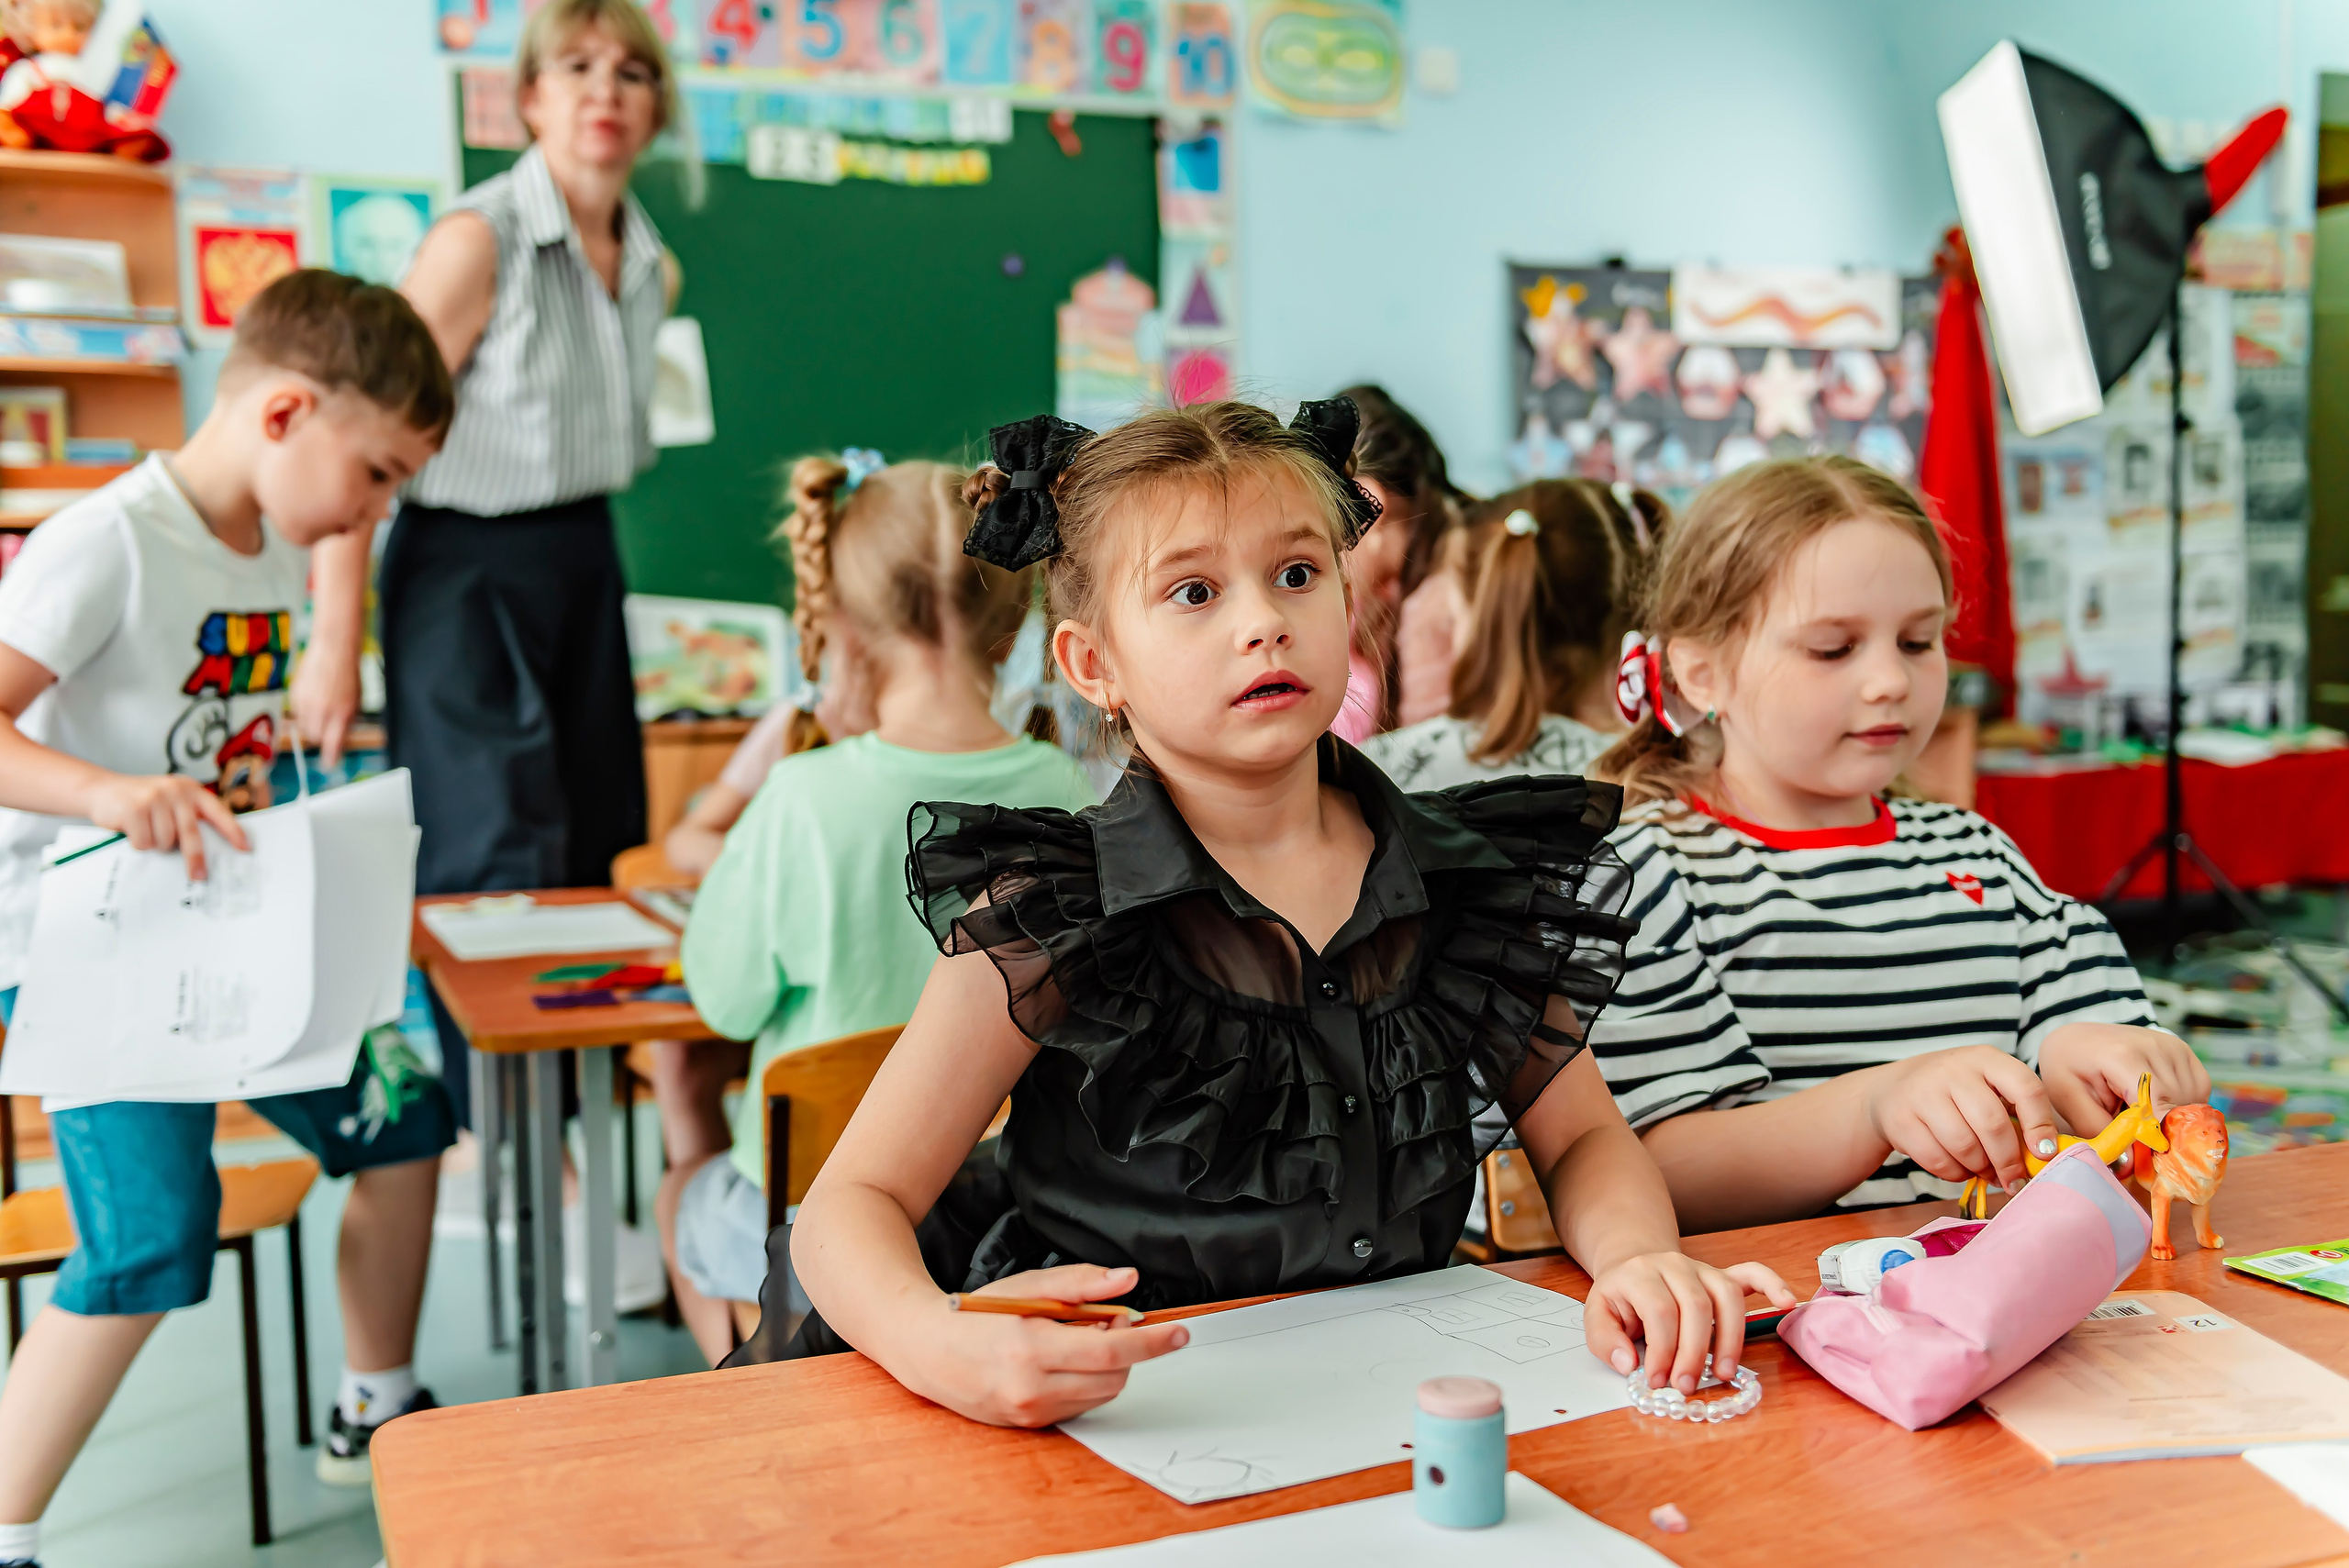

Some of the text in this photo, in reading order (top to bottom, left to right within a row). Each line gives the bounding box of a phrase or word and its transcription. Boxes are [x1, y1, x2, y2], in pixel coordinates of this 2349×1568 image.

[706, 0, 755, 52] 4
[797, 0, 845, 61] 5
[877, 0, 926, 68] 6
[949, 1, 998, 74] 7
[1030, 20, 1077, 93] 8
[1104, 22, 1145, 92] 9
[1175, 33, 1235, 97] 10
